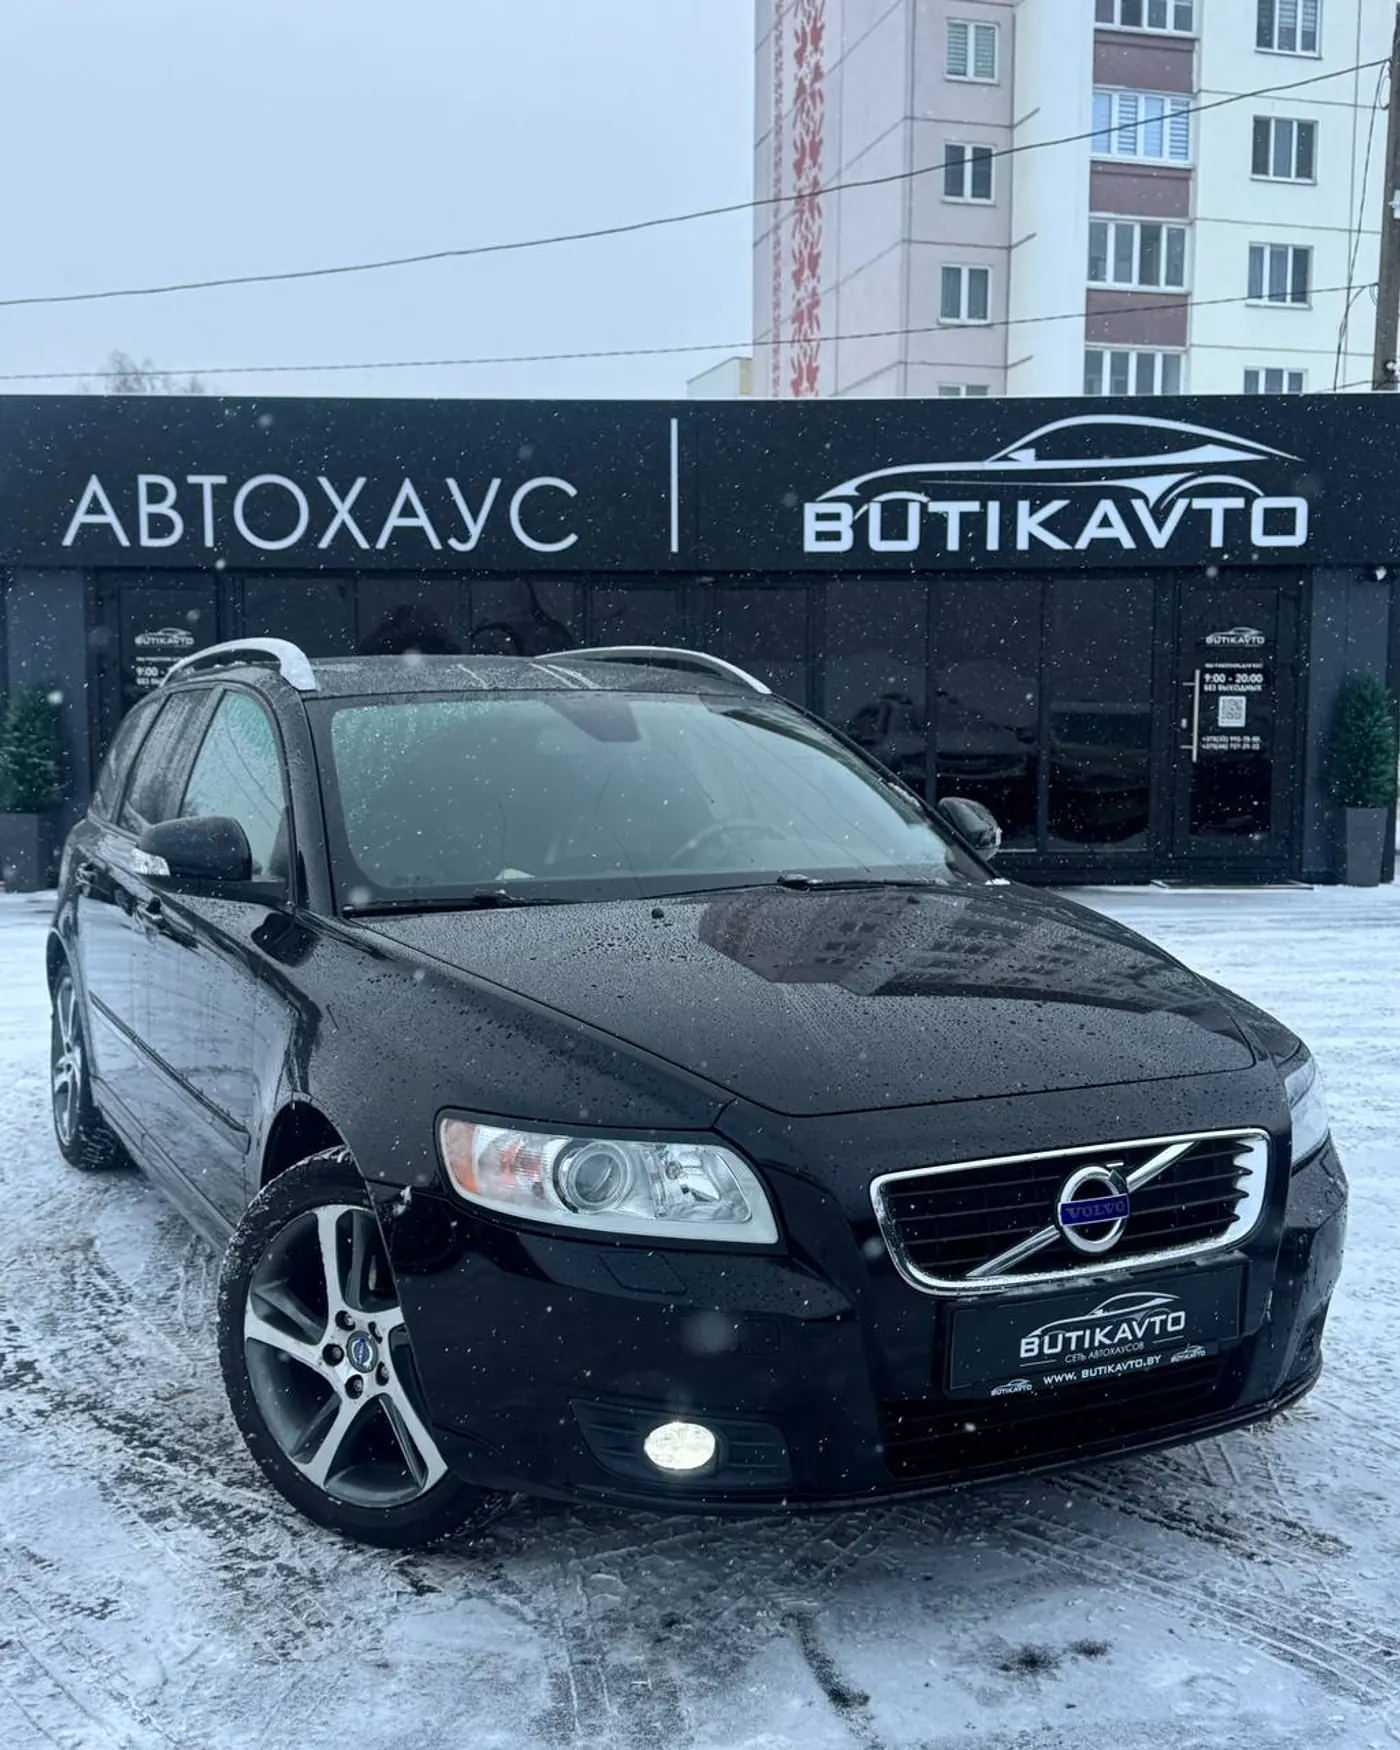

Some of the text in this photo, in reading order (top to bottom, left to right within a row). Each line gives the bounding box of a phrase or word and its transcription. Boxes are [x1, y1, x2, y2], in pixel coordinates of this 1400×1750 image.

[62, 473, 579, 552] АВТОХАУС
[803, 495, 1309, 554] BUTIKAVTO
[1205, 635, 1265, 645] BUTIKAVTO
[1065, 1201, 1126, 1219] VOLVO
[1019, 1310, 1186, 1359] BUTIKAVTO
[1064, 1342, 1145, 1364] СЕТЬ АВТОХАУСОВ
[1081, 1354, 1162, 1379] BUTIKAVTO.BY
